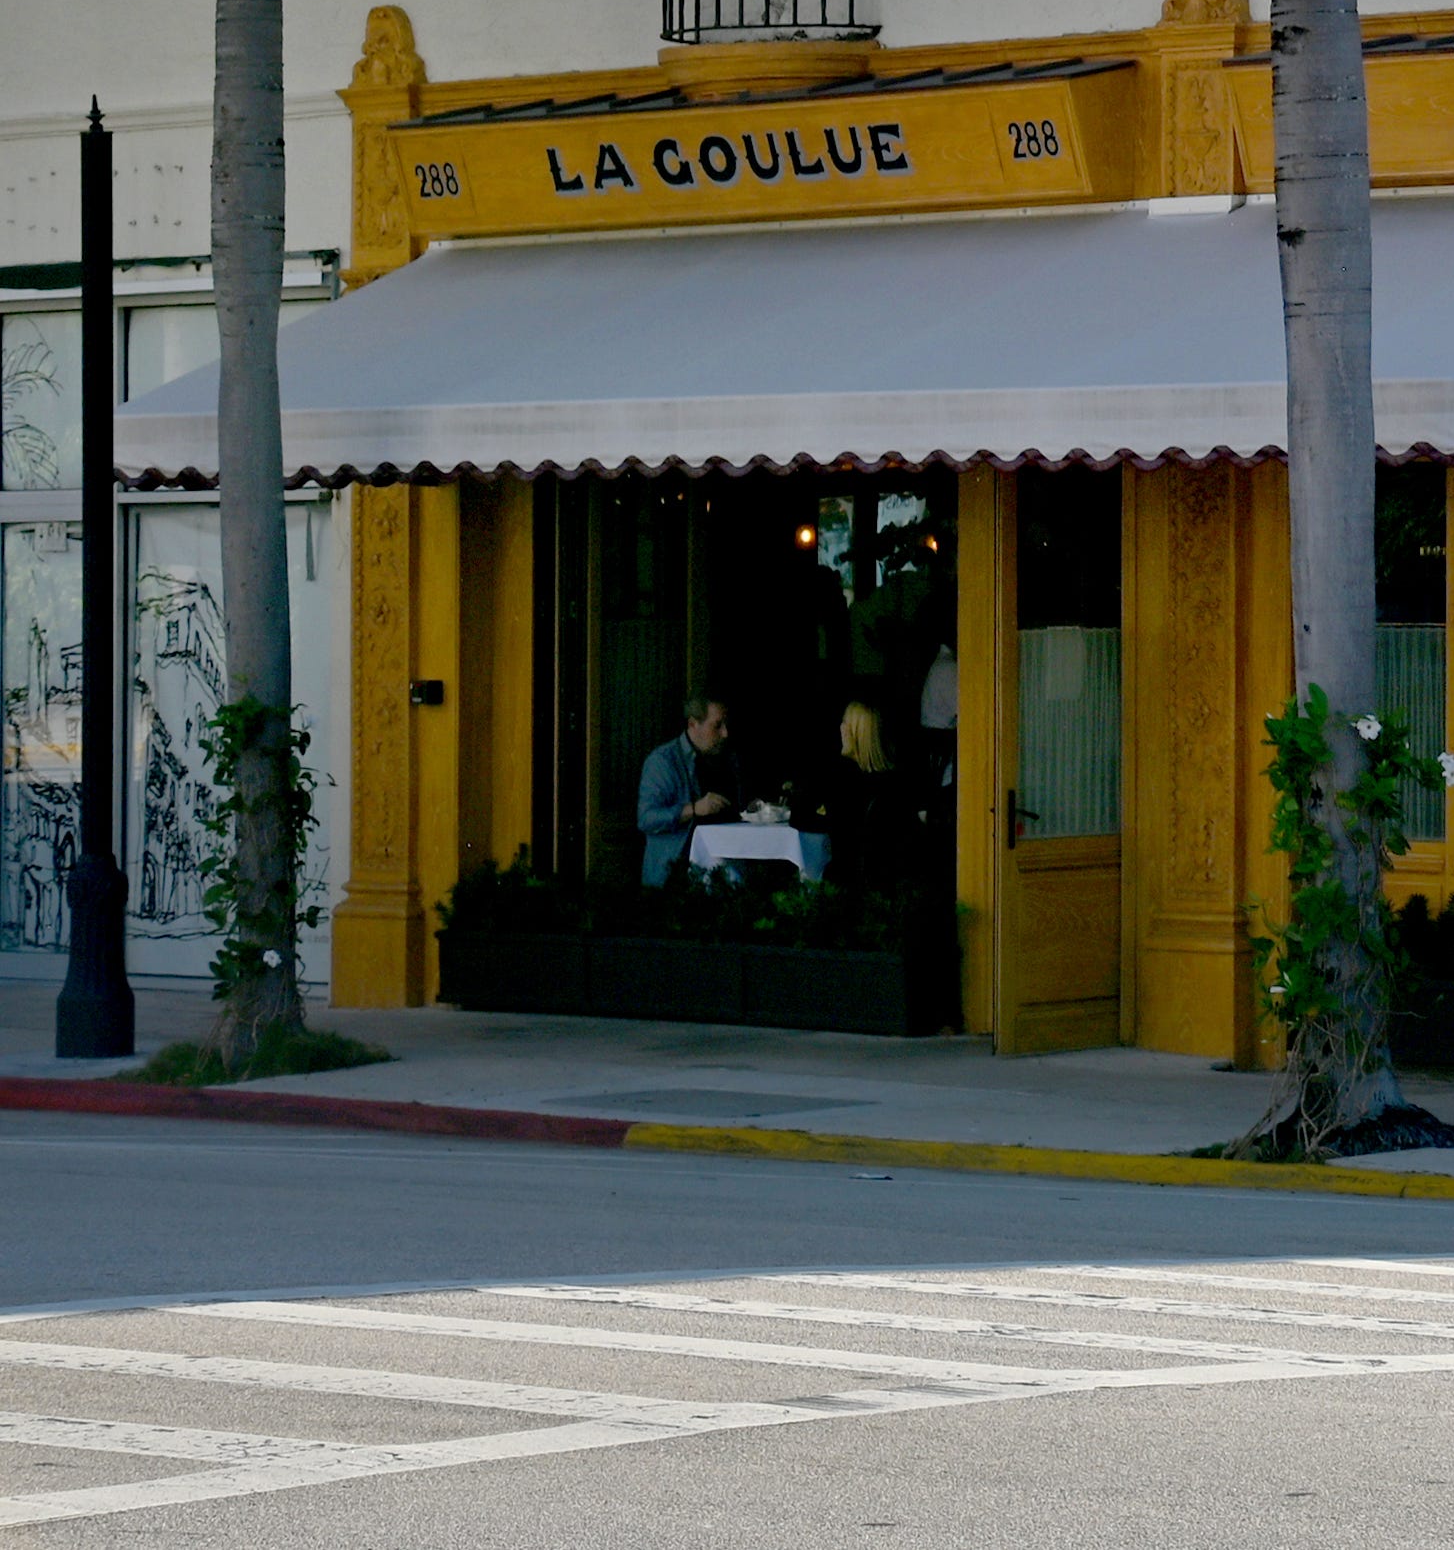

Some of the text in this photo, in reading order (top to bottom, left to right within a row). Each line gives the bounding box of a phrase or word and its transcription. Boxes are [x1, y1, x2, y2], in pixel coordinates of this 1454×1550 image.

[546, 123, 909, 192] LA GOULUE
[1008, 119, 1059, 159] 288
[414, 162, 459, 198] 288
